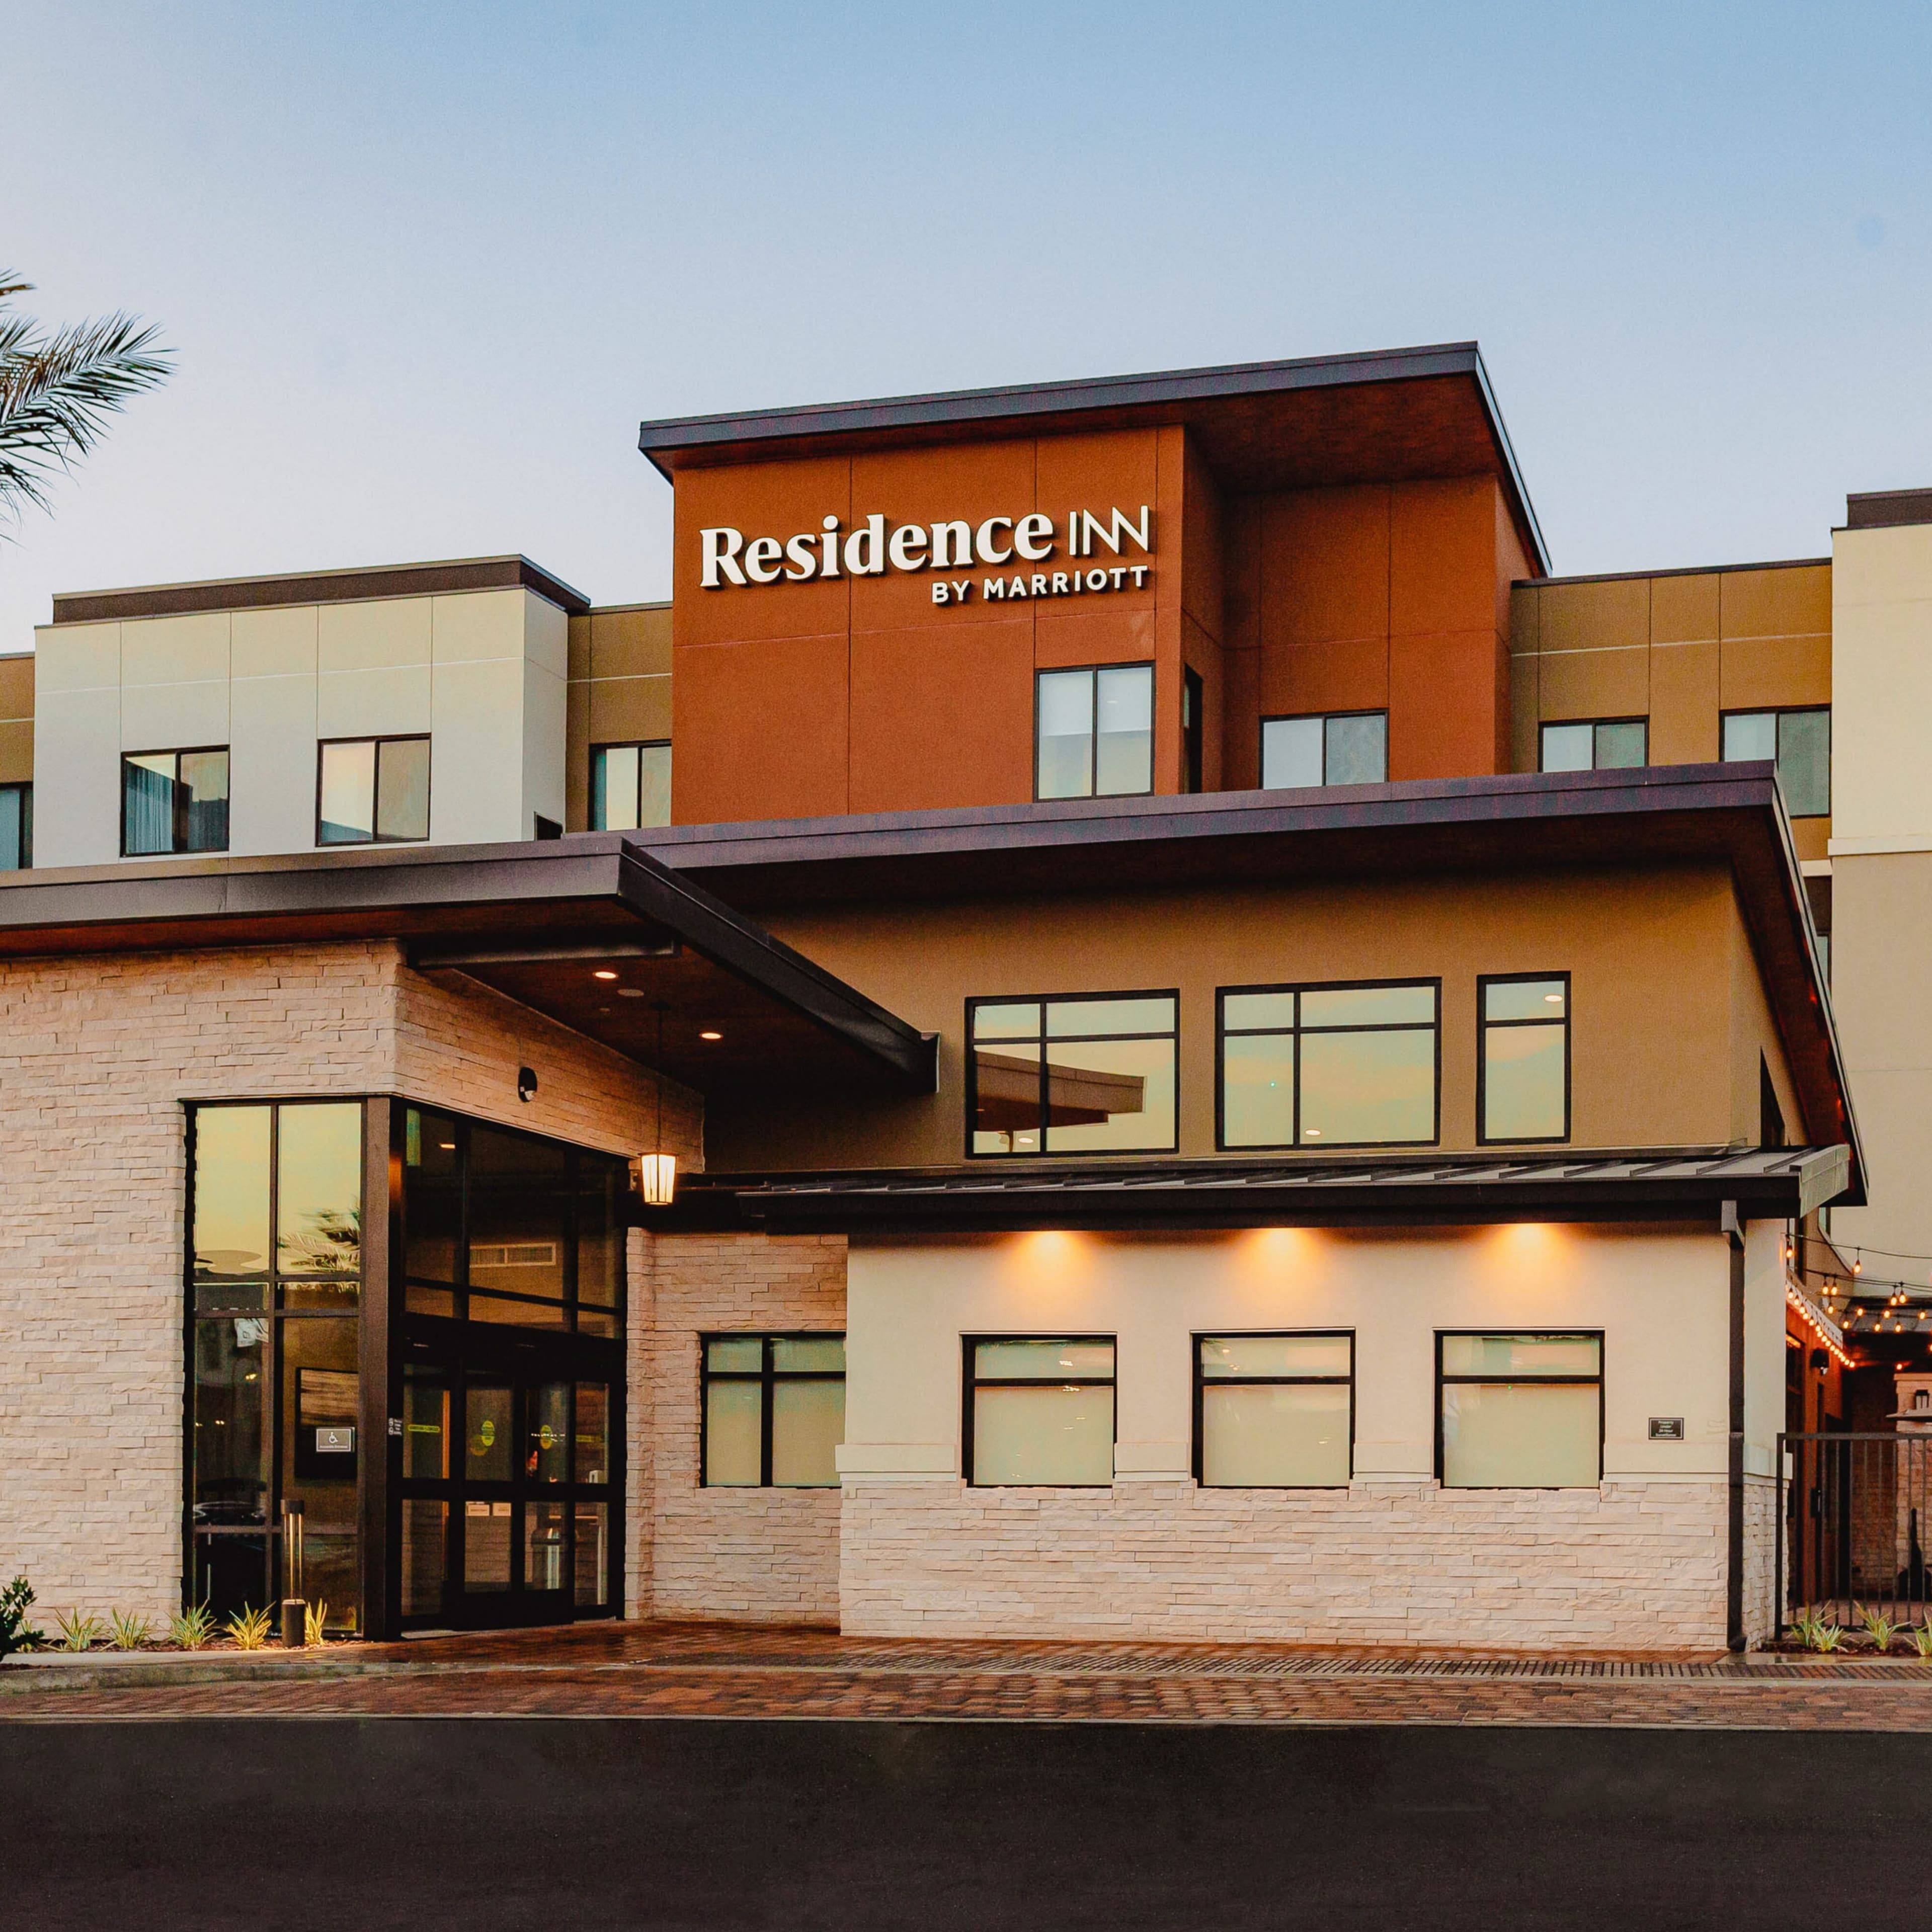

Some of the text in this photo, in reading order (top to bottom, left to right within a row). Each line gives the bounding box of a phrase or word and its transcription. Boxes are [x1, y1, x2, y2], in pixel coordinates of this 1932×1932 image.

[699, 505, 1149, 587] Residence INN
[931, 565, 1148, 603] BY MARRIOTT
